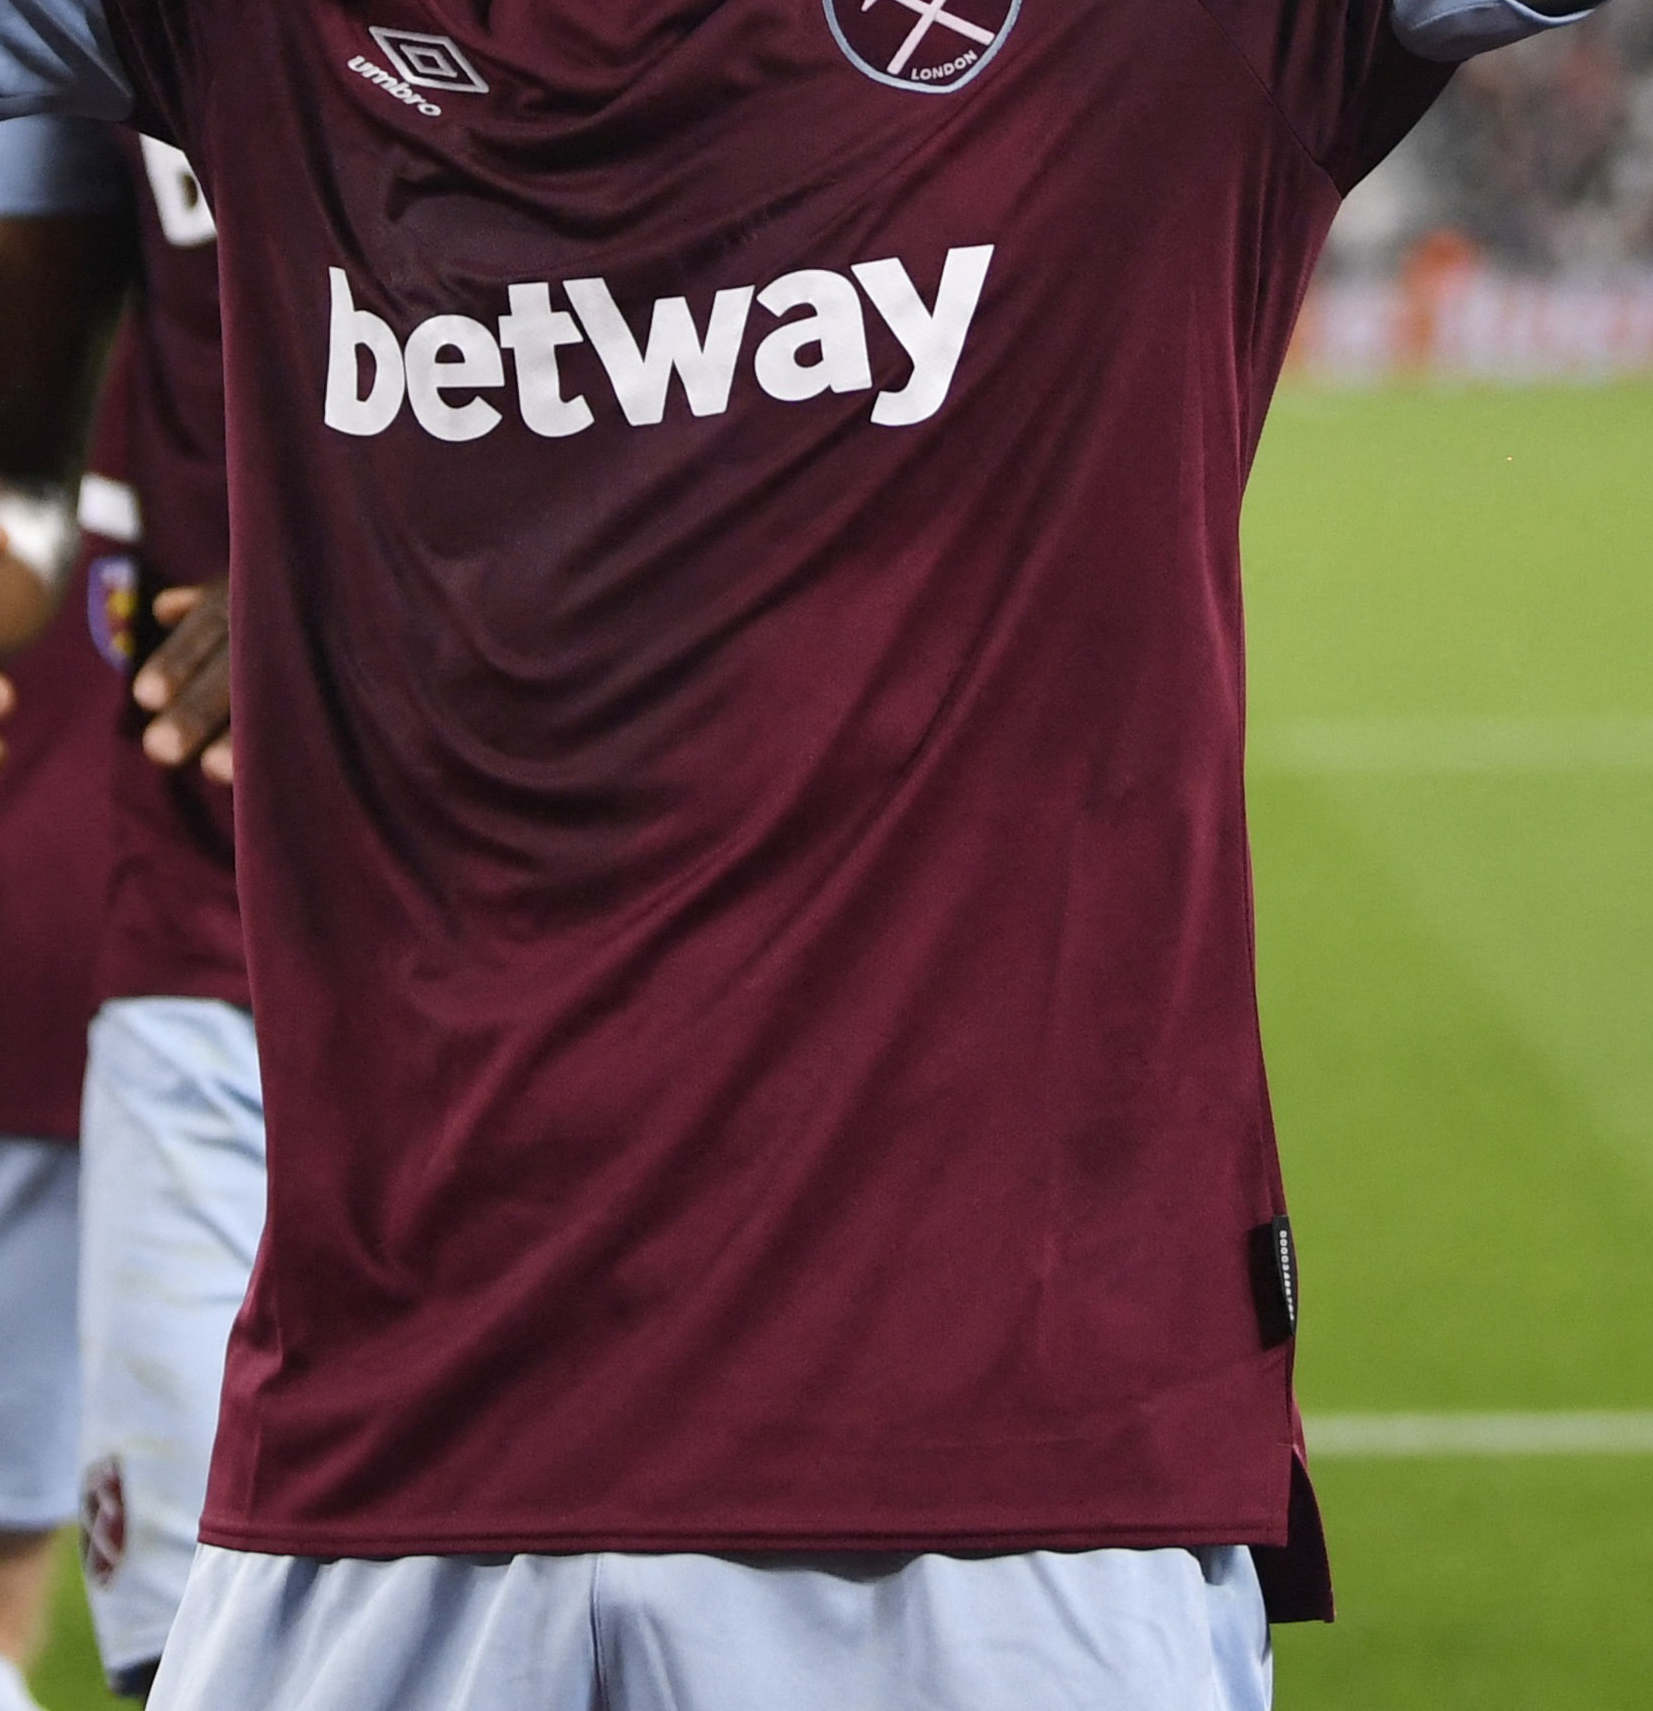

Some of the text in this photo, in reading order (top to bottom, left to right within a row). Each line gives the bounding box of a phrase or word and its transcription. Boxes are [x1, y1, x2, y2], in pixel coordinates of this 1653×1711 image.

[347, 55, 442, 117] umbro
[910, 49, 978, 81] LONDON
[324, 244, 995, 443] betway
